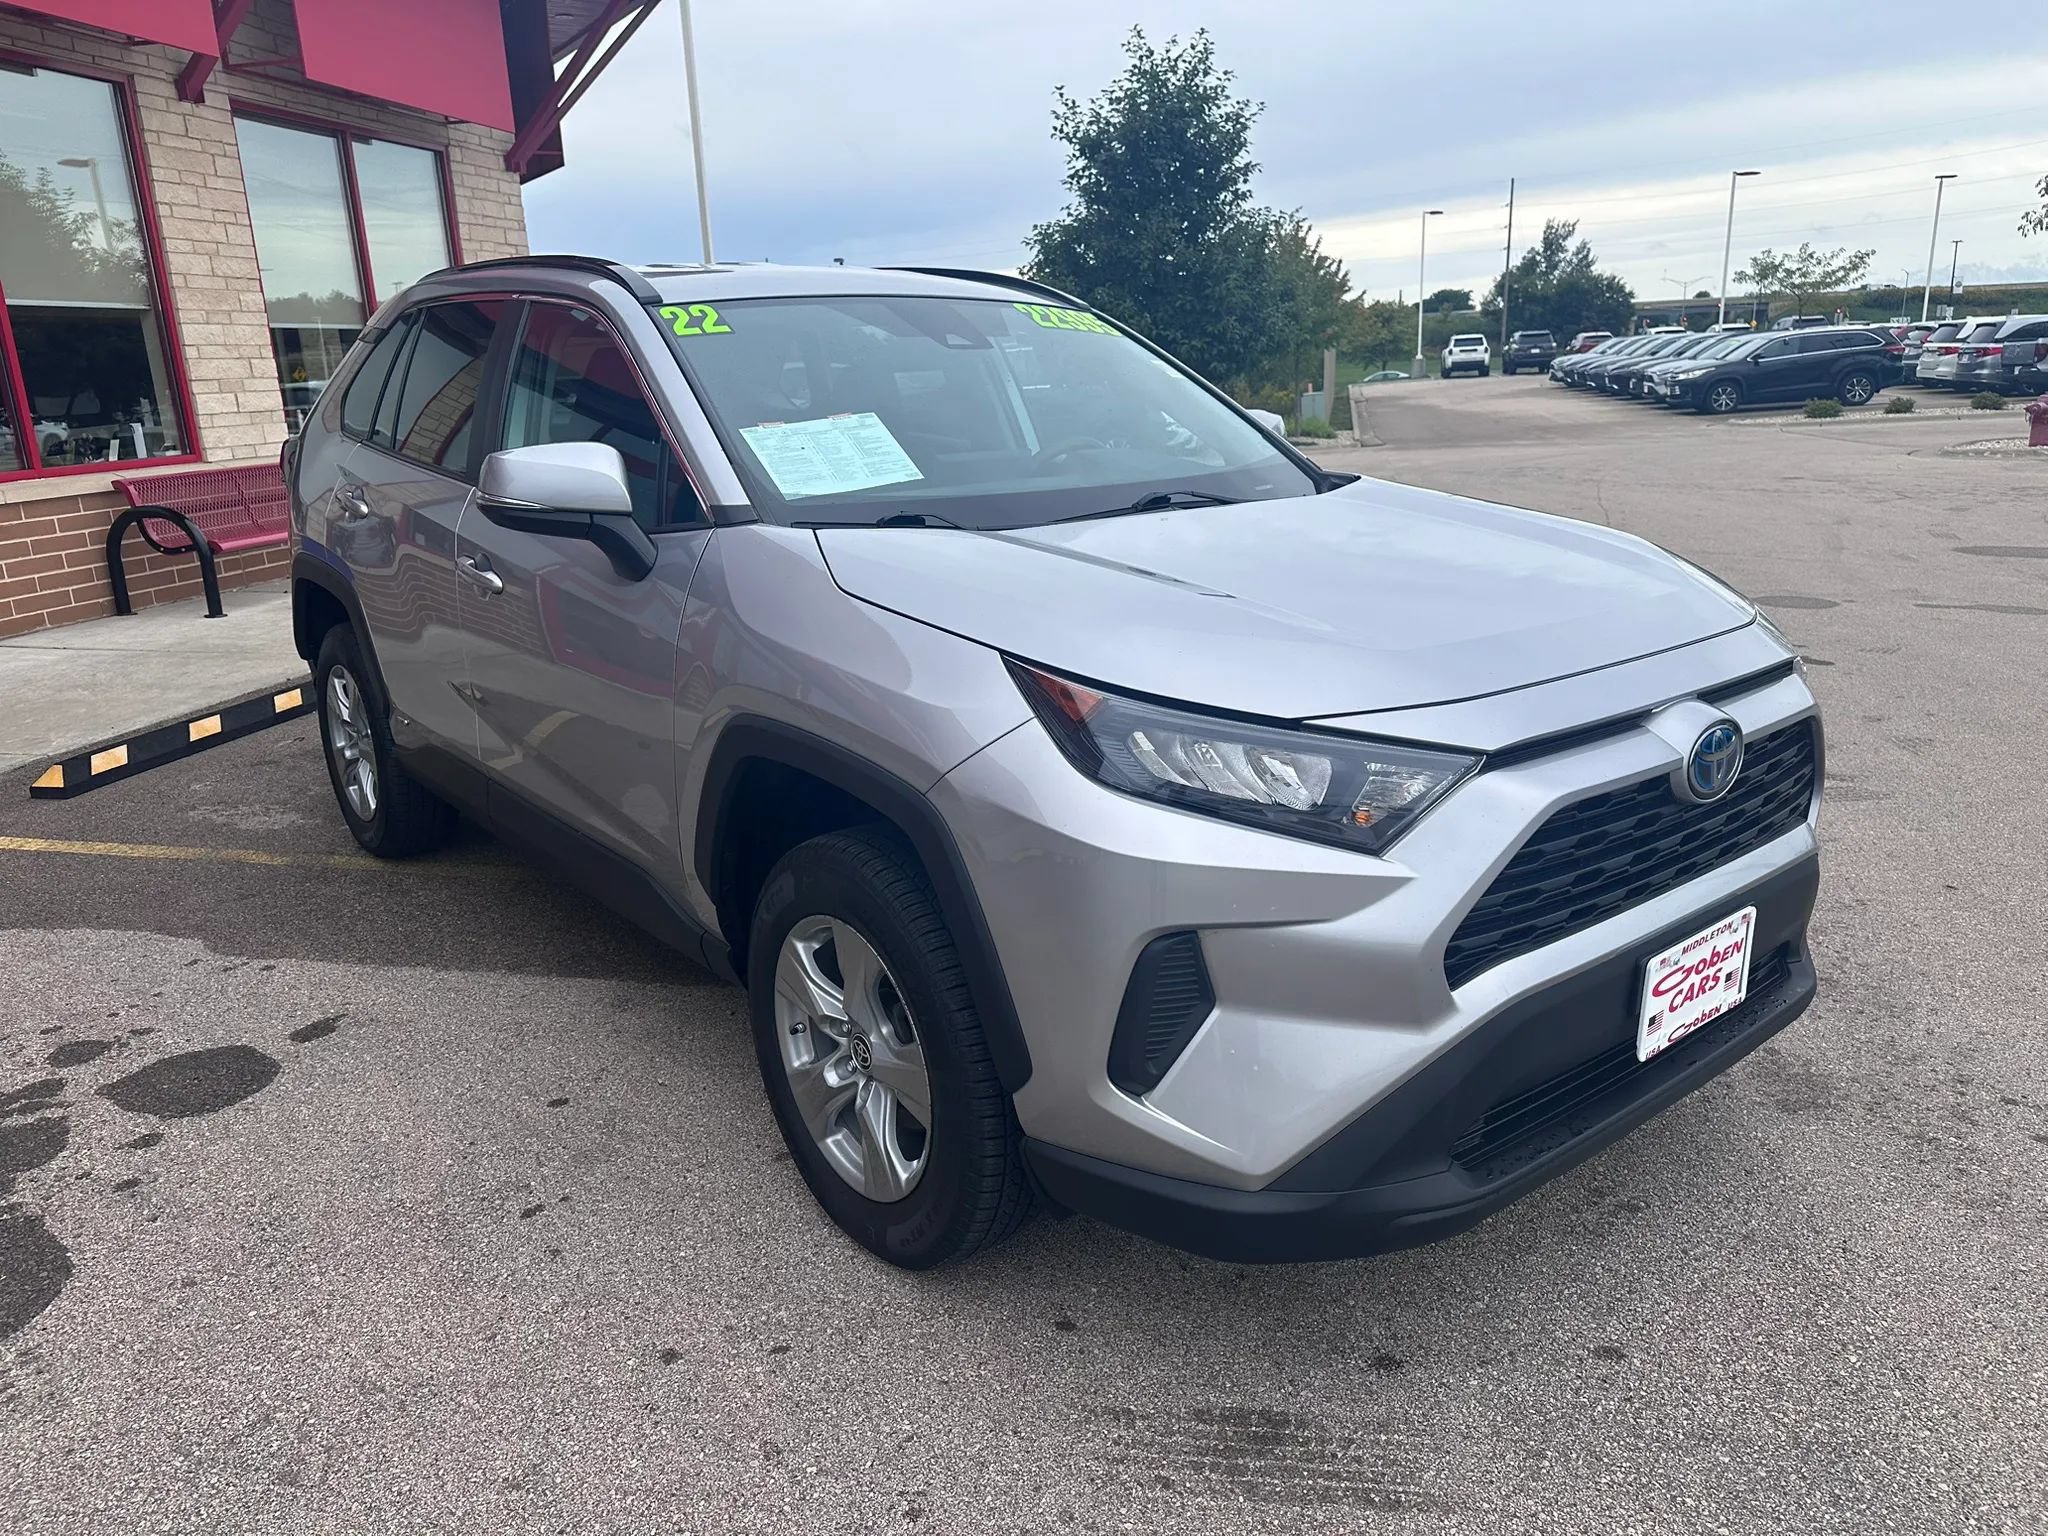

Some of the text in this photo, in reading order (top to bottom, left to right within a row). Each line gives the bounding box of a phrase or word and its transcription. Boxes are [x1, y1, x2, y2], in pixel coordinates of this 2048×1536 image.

[660, 304, 732, 336] 22
[1681, 921, 1734, 956] MIDDLETON
[1668, 967, 1723, 1013] CARS
